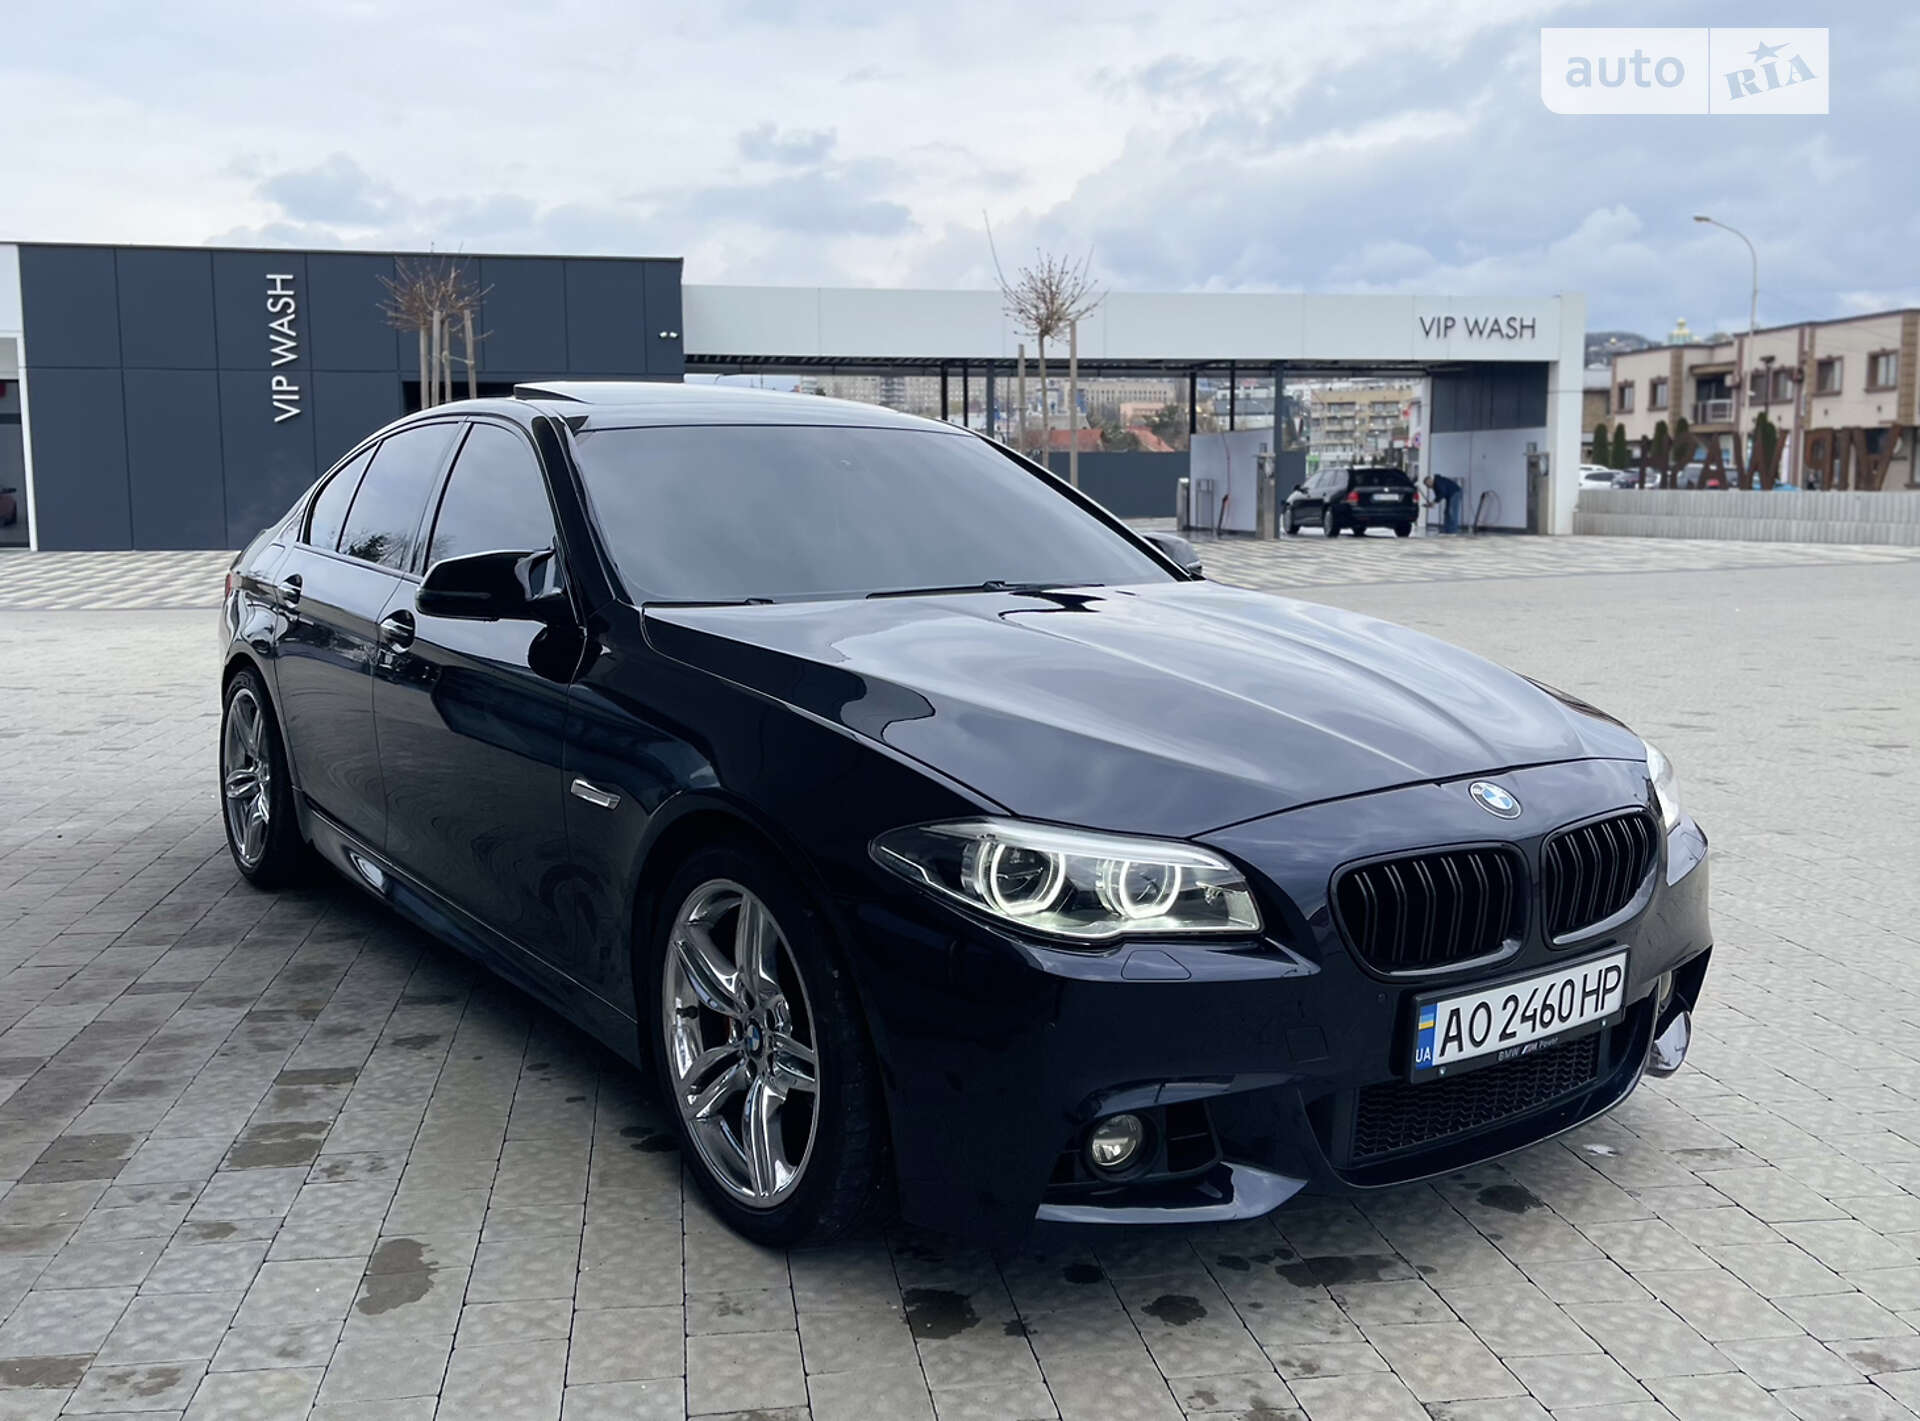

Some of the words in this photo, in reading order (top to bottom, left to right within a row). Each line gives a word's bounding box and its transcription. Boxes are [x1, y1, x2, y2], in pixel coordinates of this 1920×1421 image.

[266, 274, 298, 366] WASH
[1419, 316, 1456, 339] VIP
[1463, 316, 1536, 339] WASH
[271, 375, 301, 422] VIP
[1439, 1000, 1492, 1057] AO
[1499, 978, 1575, 1042] 2460
[1415, 1047, 1431, 1063] UA
